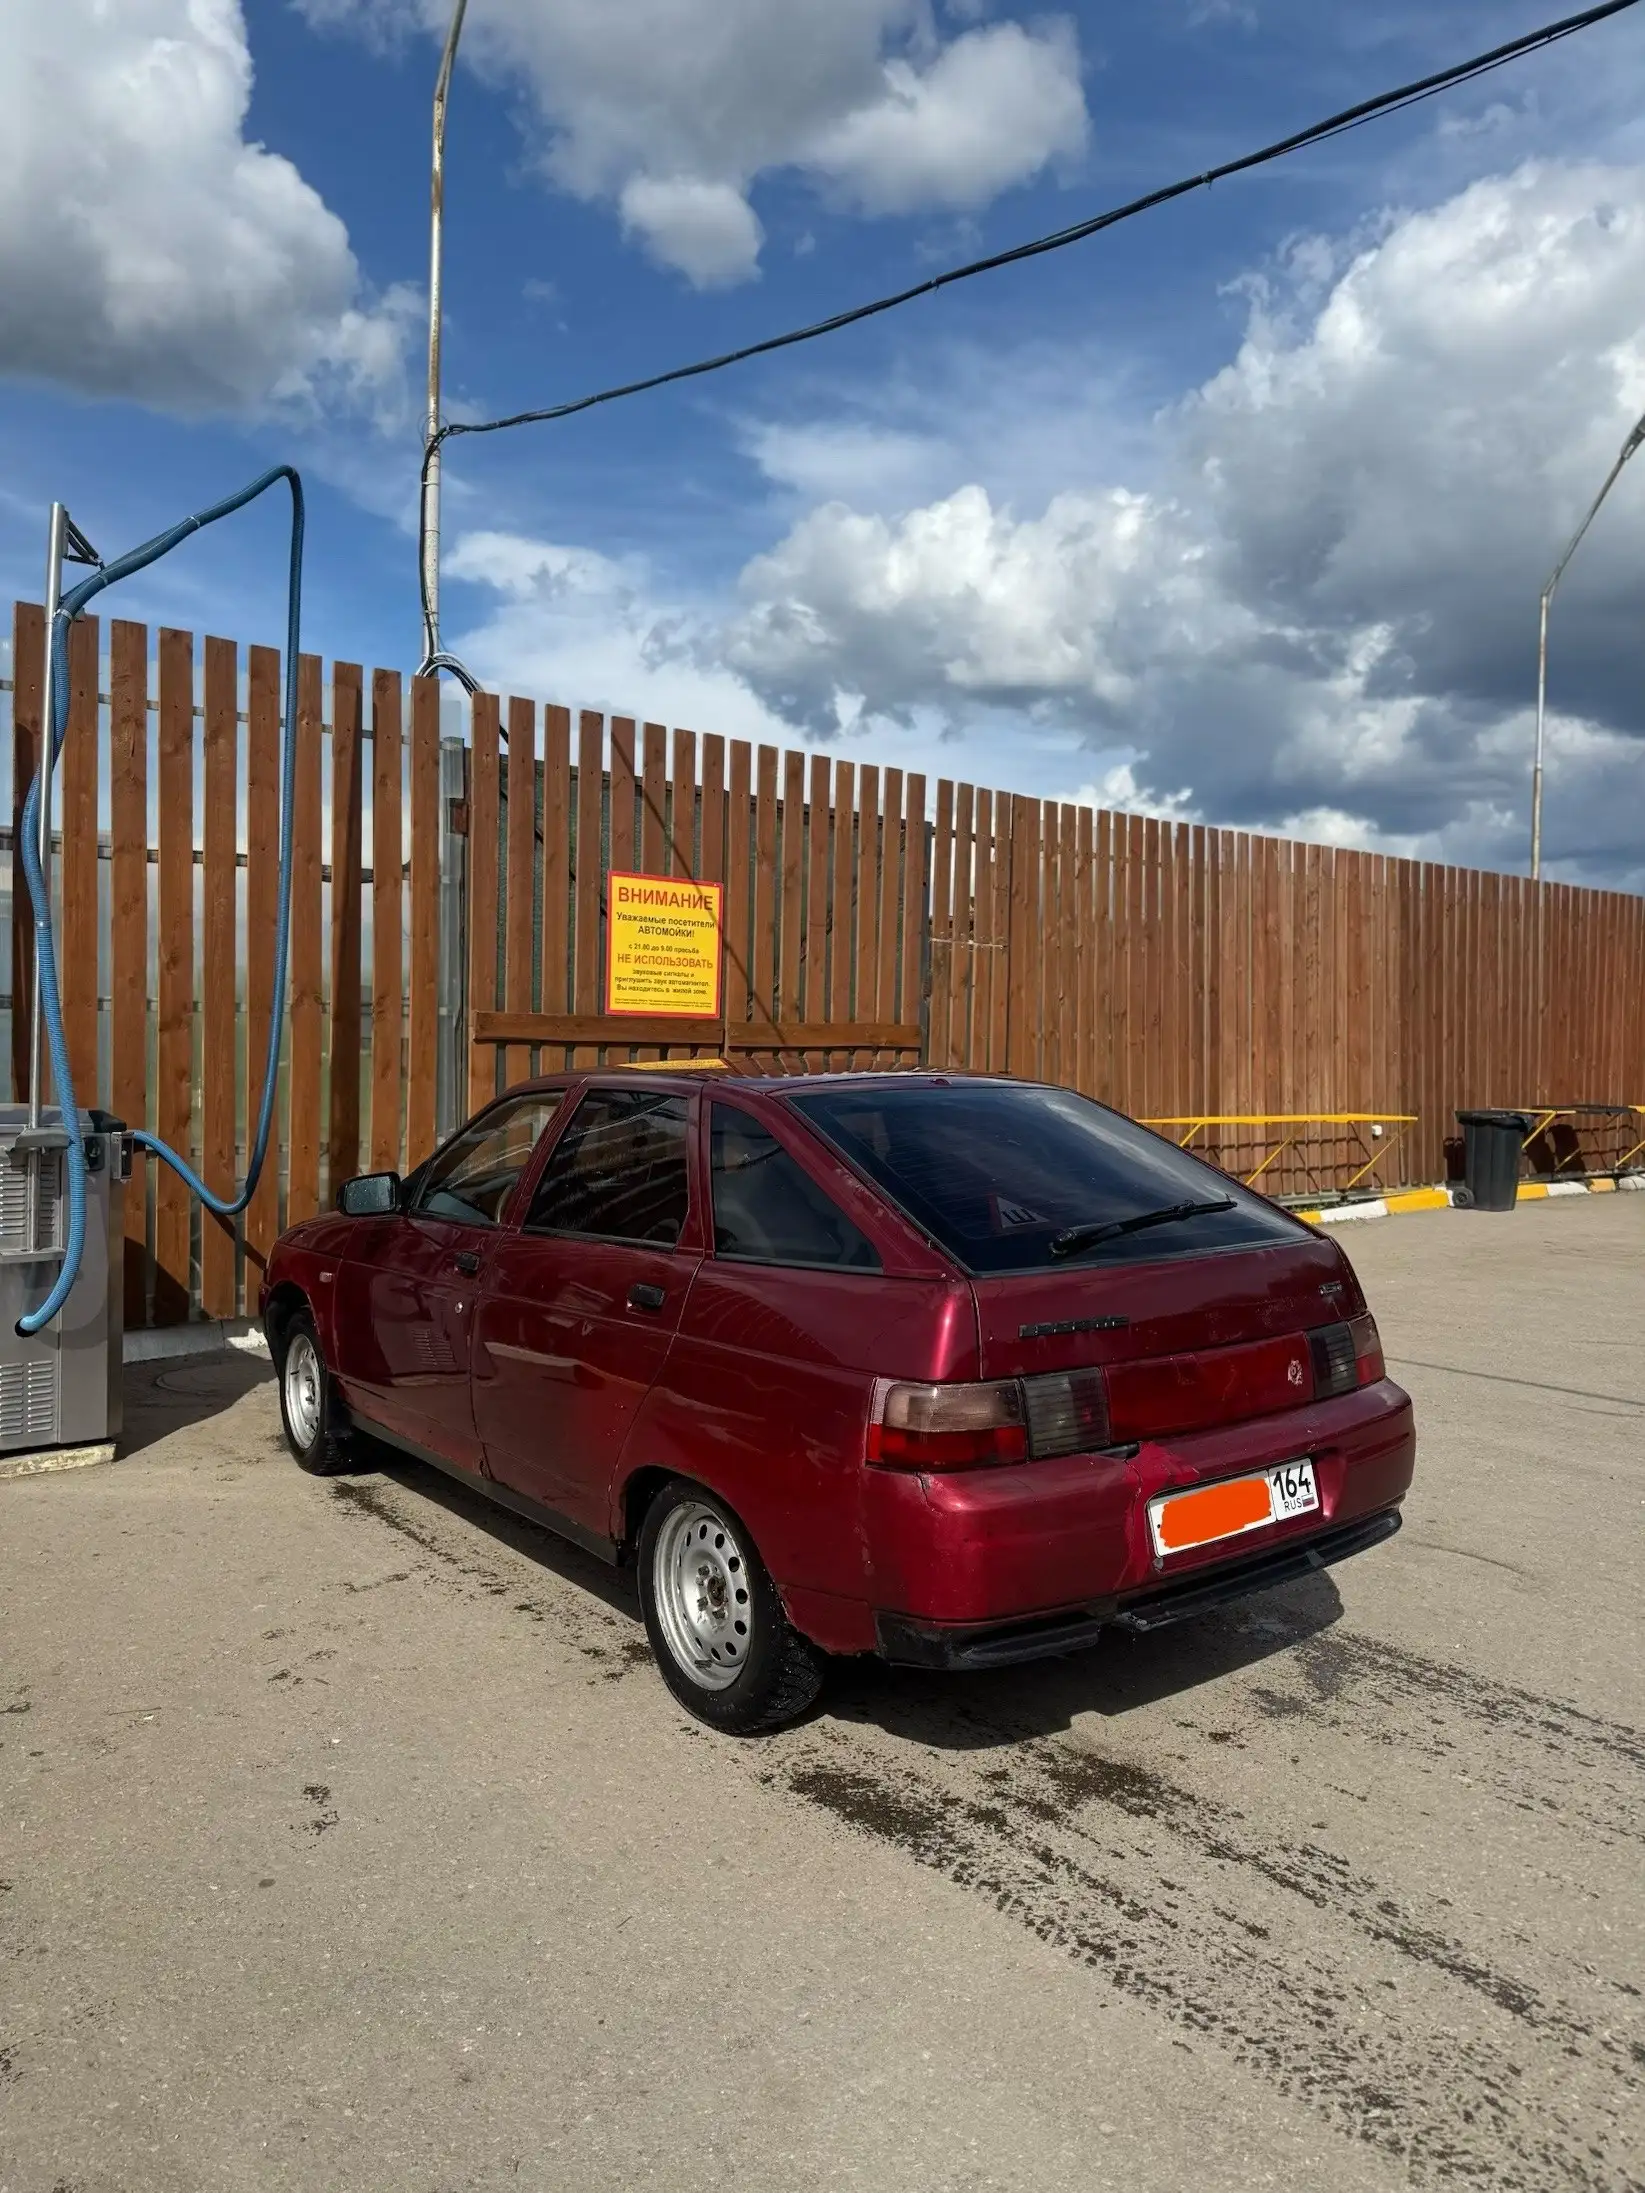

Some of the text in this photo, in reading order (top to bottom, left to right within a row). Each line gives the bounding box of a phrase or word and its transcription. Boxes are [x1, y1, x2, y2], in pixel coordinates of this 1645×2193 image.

[618, 887, 713, 911] ВНИМАНИЕ
[616, 911, 715, 928] Уважаемые посетители
[638, 926, 695, 938] АВТОМОЙКИ!
[617, 953, 713, 969] НЕ ИСПОЛЬЗОВАТЬ
[615, 976, 652, 984] приглушить
[1272, 1464, 1311, 1501] 164
[1284, 1497, 1303, 1512] RUS
